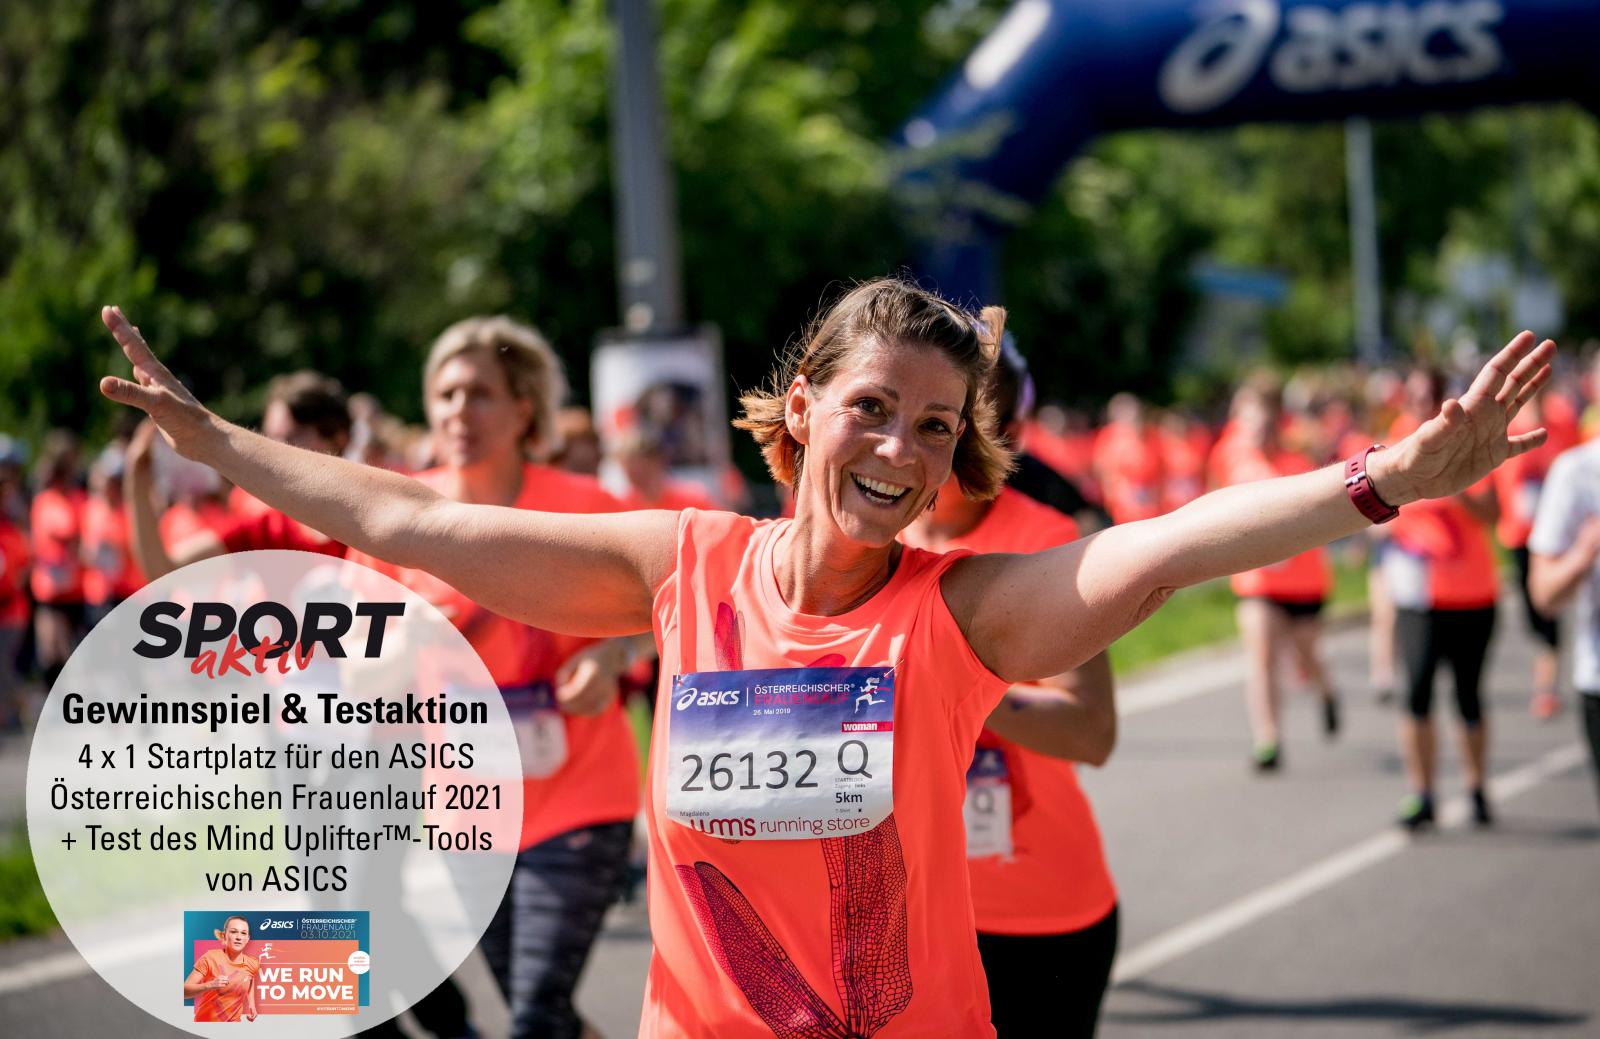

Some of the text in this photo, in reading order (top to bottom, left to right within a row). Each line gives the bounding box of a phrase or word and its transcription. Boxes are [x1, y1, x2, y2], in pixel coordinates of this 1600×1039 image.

[697, 690, 740, 706] asics
[755, 692, 849, 706] FRAUENLAUF
[776, 707, 791, 715] 2019
[843, 722, 877, 732] woman
[837, 740, 872, 779] Q
[681, 749, 818, 792] 26132
[835, 792, 863, 804] 5km
[760, 818, 823, 834] running
[827, 817, 869, 831] store
